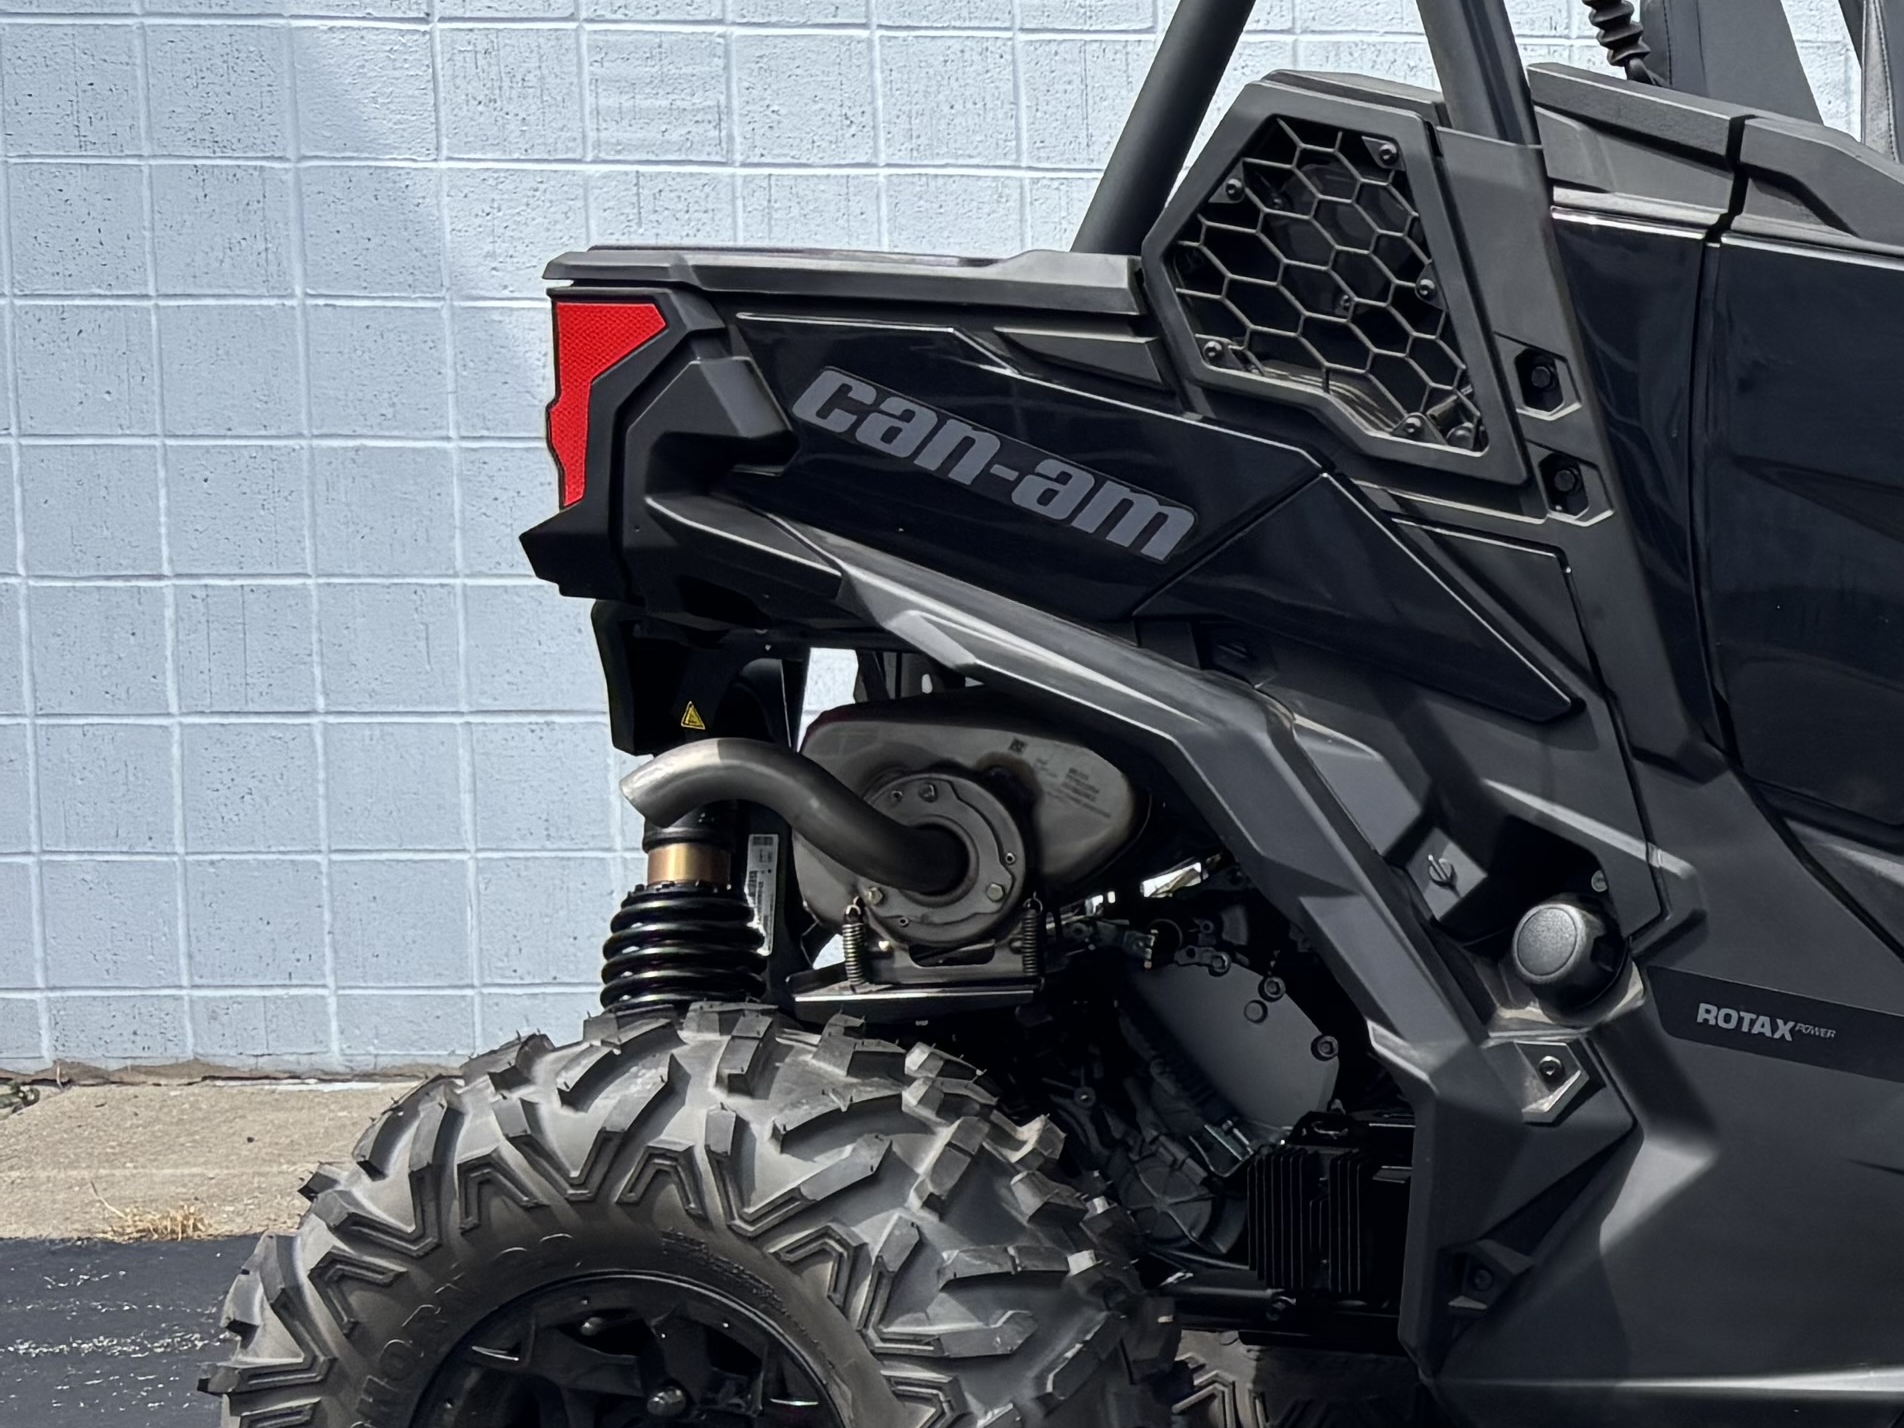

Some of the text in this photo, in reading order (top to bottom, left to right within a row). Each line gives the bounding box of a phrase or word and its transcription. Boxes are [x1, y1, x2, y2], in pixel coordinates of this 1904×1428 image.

[792, 369, 1195, 563] can-am
[1697, 1003, 1836, 1041] ROTAX POWER
